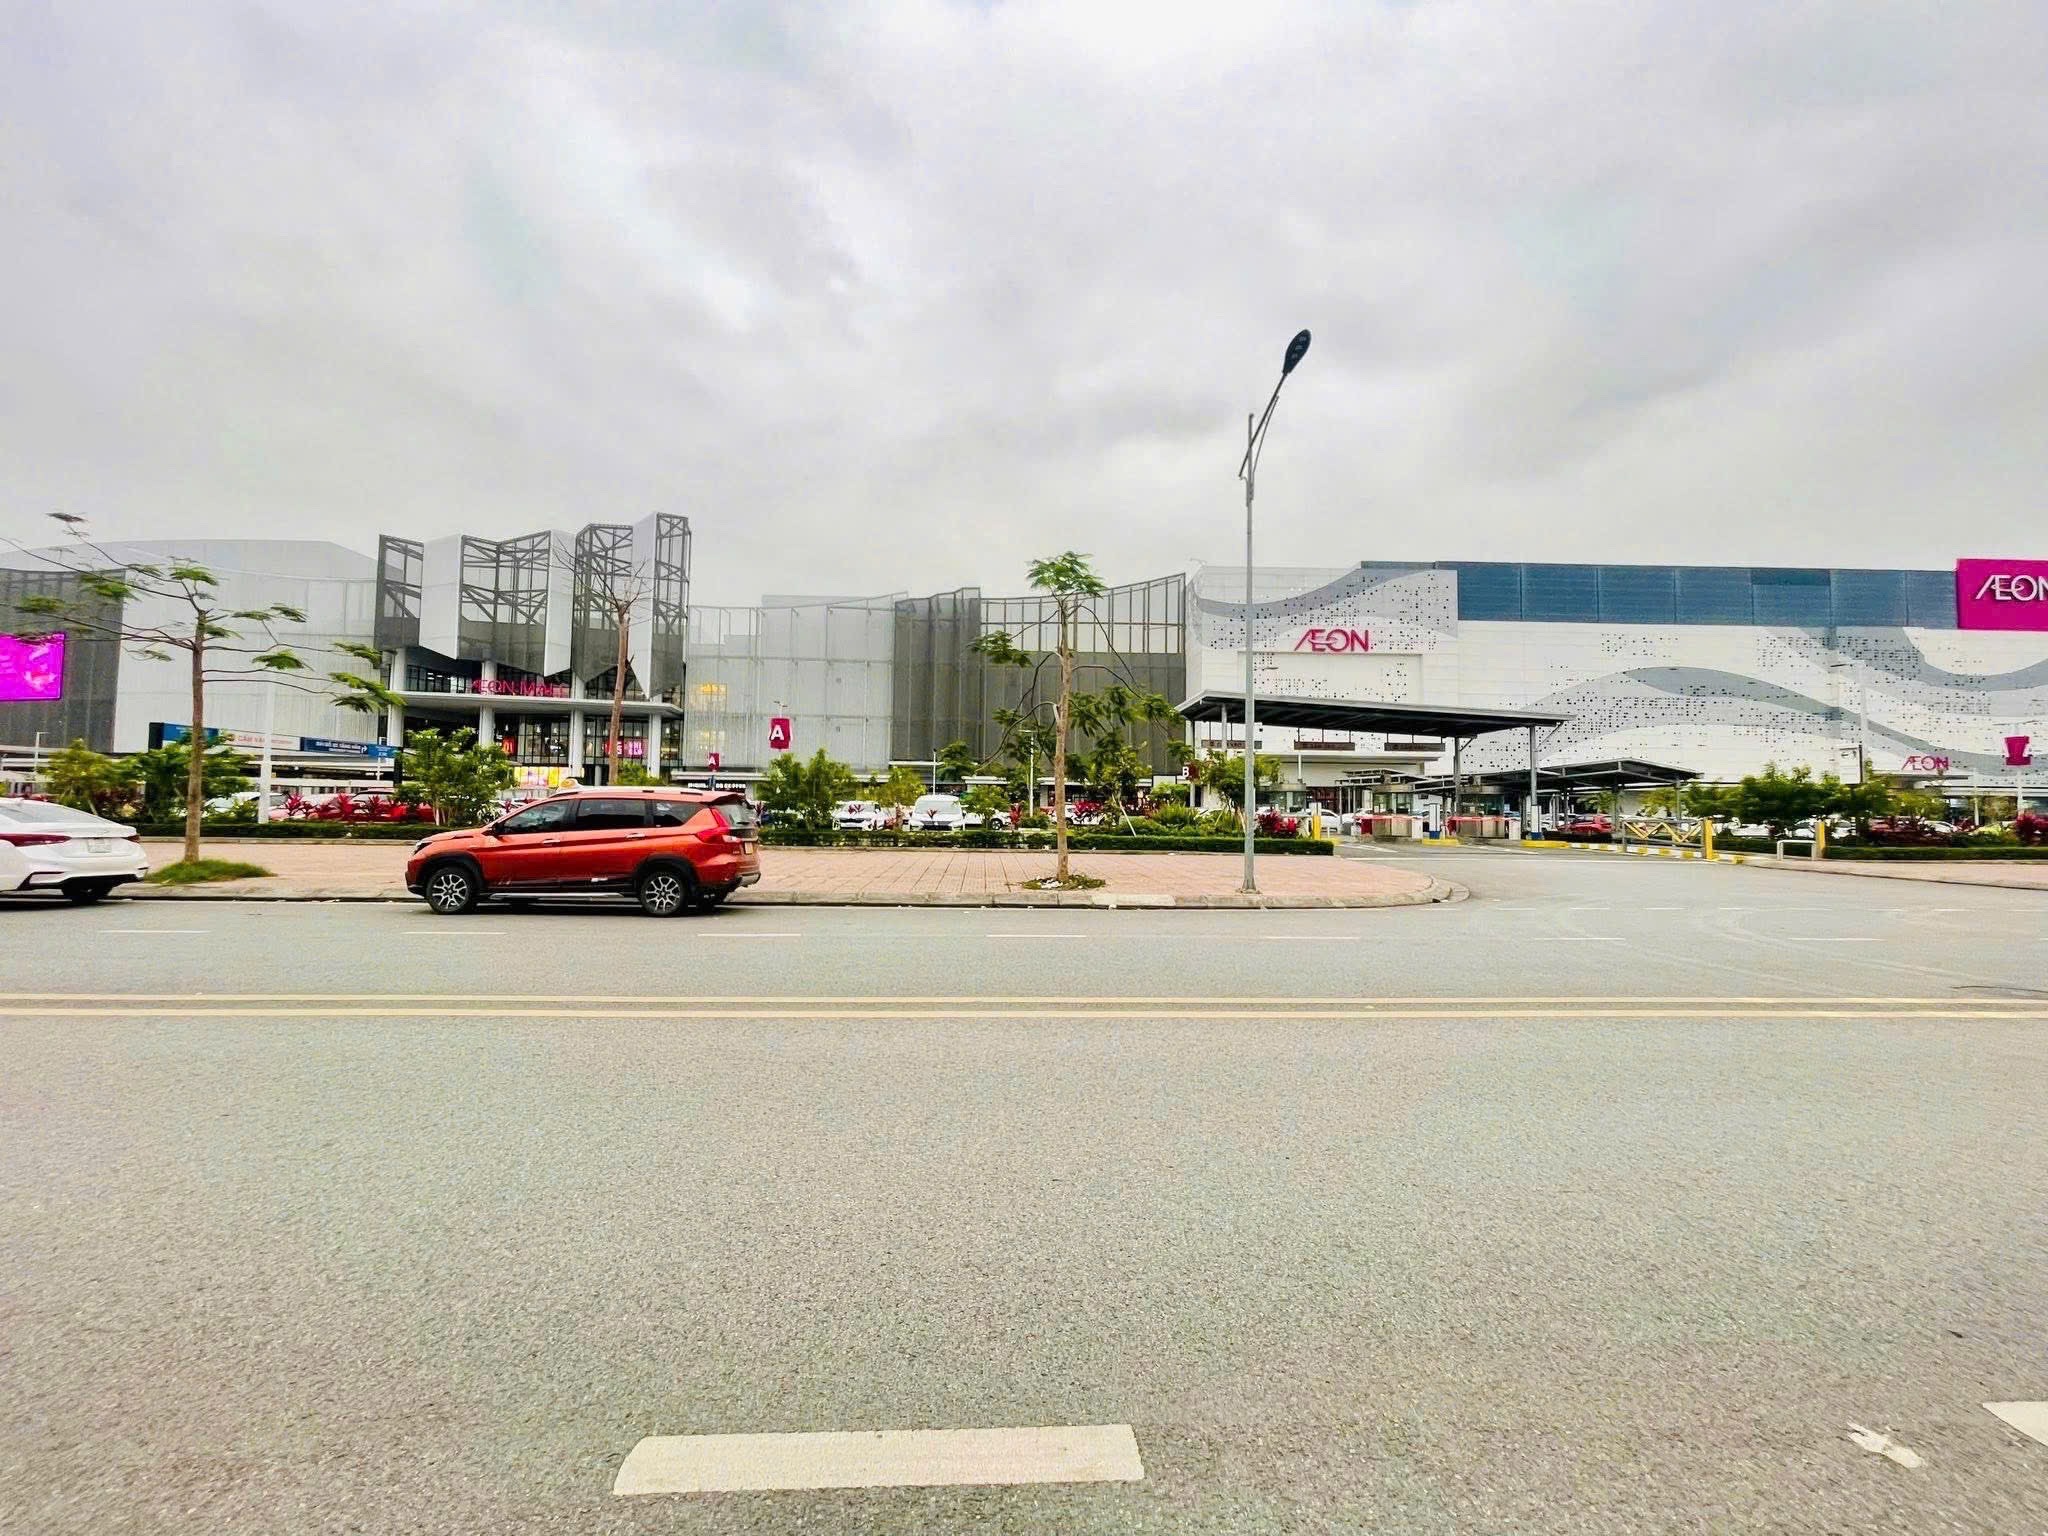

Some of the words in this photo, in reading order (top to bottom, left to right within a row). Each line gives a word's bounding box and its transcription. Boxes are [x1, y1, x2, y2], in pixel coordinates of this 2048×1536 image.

[770, 724, 785, 741] A
[708, 755, 717, 766] A
[1182, 766, 1190, 777] B
